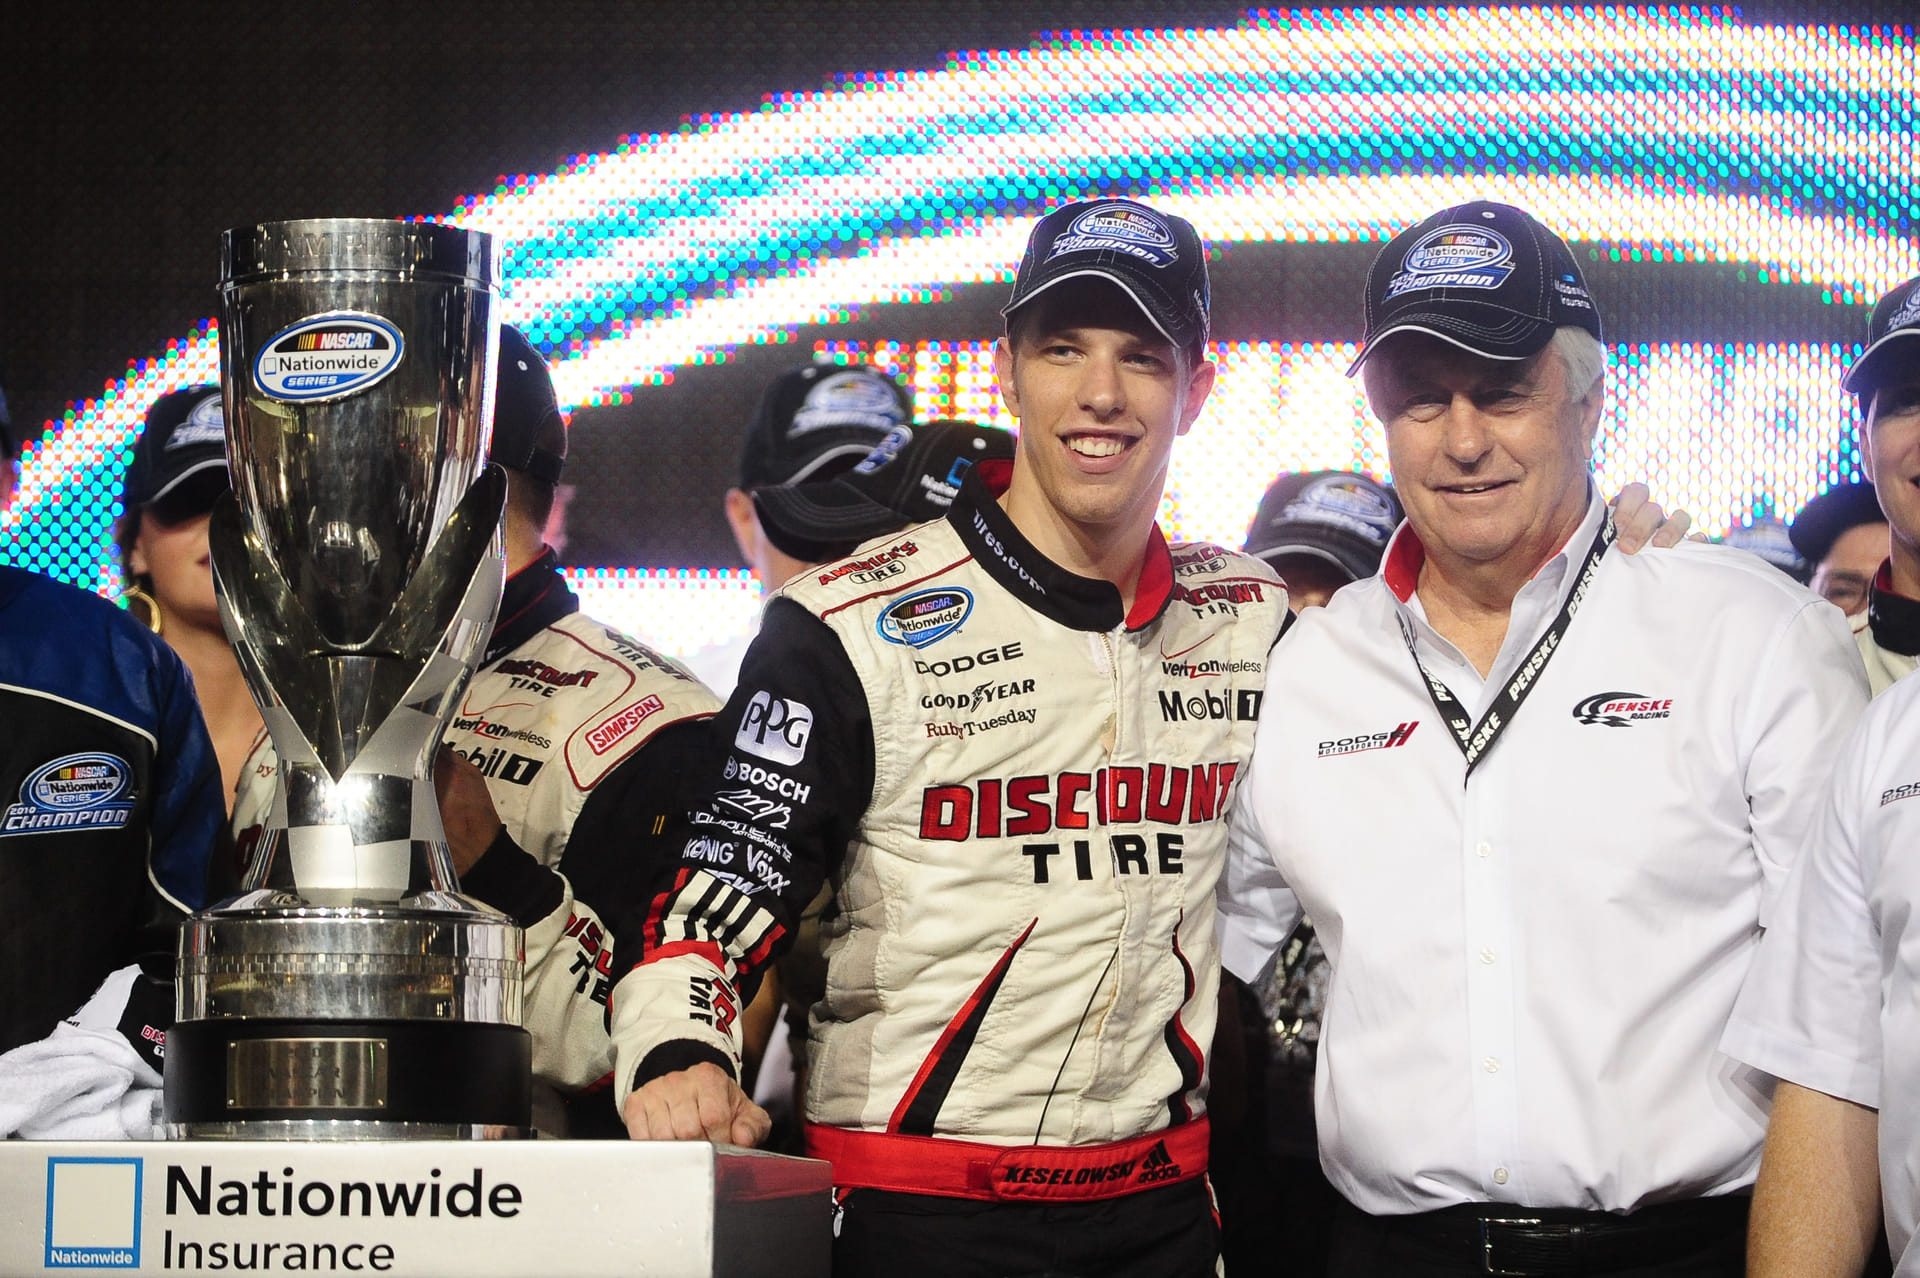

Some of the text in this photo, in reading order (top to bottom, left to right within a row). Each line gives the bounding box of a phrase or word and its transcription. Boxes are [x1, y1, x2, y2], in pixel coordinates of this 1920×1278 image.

[1096, 217, 1162, 242] Nationwide
[1426, 245, 1495, 259] Nationwide
[1457, 236, 1487, 247] NASCAR
[1422, 257, 1465, 268] SERIES
[320, 332, 373, 349] NASCAR
[280, 355, 379, 371] Nationwide
[287, 374, 338, 387] SERIES
[855, 563, 902, 583] TIRE
[1567, 551, 1601, 621] PENSKE
[1192, 602, 1239, 619] TIRE
[914, 641, 1024, 678] DODGE
[1507, 630, 1560, 702] PENSKE
[509, 676, 558, 698] TIRE
[1158, 688, 1232, 721] Mobil
[1604, 699, 1673, 713] PENSKE
[1630, 710, 1671, 720] RACING
[592, 700, 662, 750] SIMPSON
[742, 701, 809, 749] PPG
[1466, 711, 1502, 764] NSKE
[1318, 741, 1384, 756] MOTORSPORTS
[75, 765, 108, 778] NASCAR
[50, 780, 114, 794] Nationwide
[738, 762, 811, 805] BOSCH
[55, 793, 93, 804] SERIES
[919, 762, 1240, 842] DISCOUNT
[6, 809, 129, 831] CHAMPION
[10, 806, 36, 816] 2010
[1022, 832, 1184, 884] TIRE
[1004, 1159, 1182, 1186] KESELOWSKI adidas
[165, 1165, 524, 1218] Nationwide
[51, 1250, 134, 1266] Nationwide
[163, 1229, 396, 1271] Insurance
